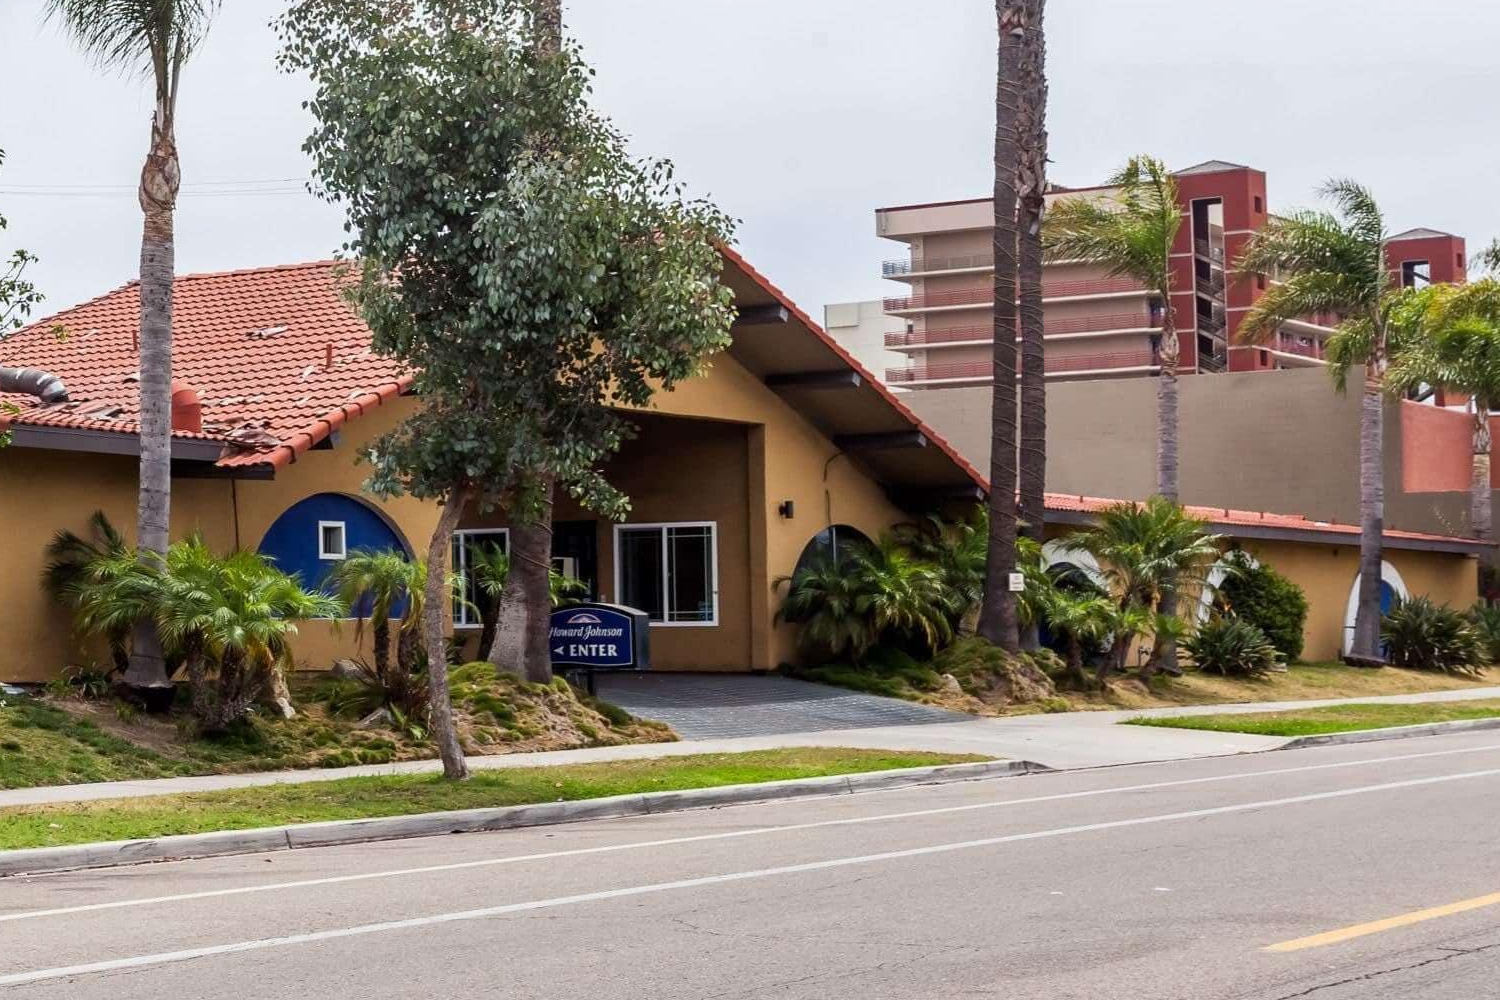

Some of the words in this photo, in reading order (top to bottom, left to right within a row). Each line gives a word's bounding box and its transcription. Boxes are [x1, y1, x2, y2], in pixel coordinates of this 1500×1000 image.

[548, 626, 584, 639] Howard
[583, 625, 623, 640] Johnson
[569, 644, 618, 657] ENTER
